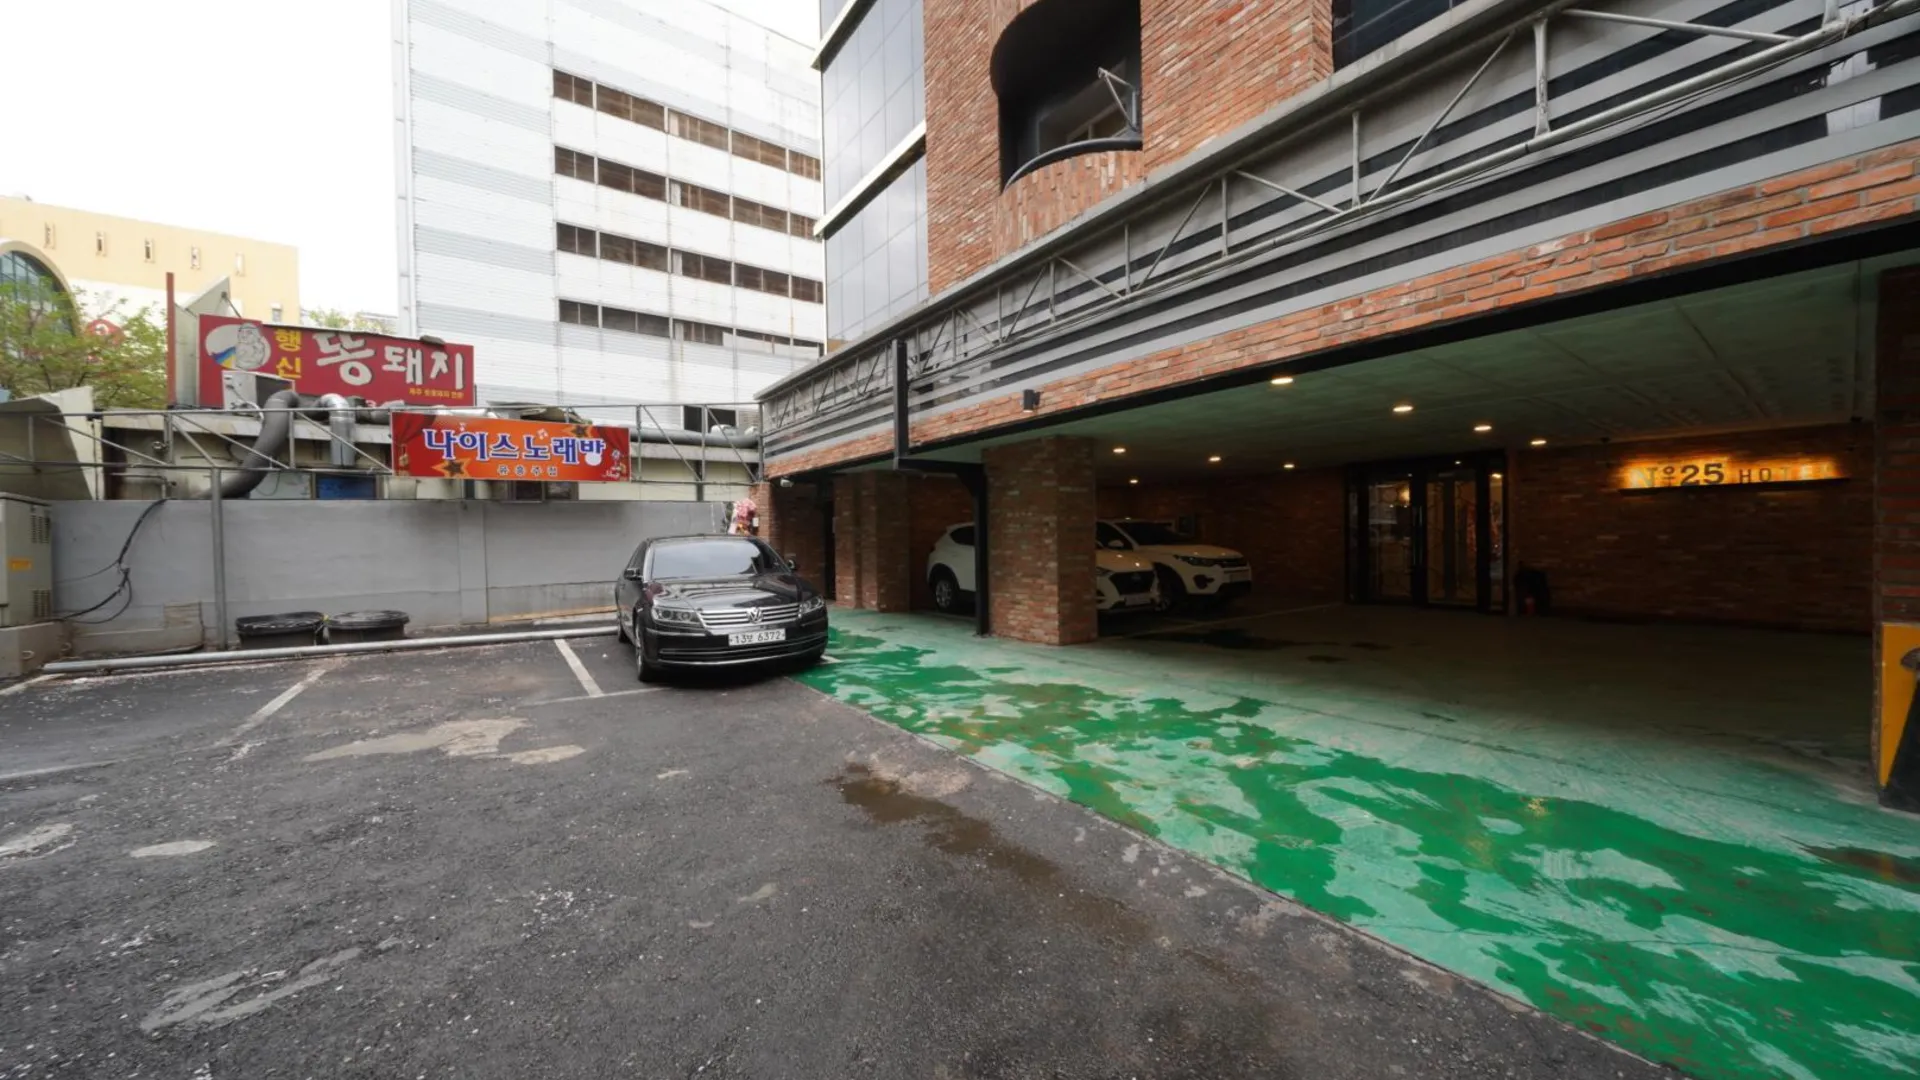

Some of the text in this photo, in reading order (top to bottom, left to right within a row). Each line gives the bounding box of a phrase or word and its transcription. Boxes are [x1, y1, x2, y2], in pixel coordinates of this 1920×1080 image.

[274, 328, 302, 379] 행신
[312, 332, 464, 390] 똥돼지
[422, 428, 606, 466] 나이스 노래방
[757, 630, 782, 642] 6372
